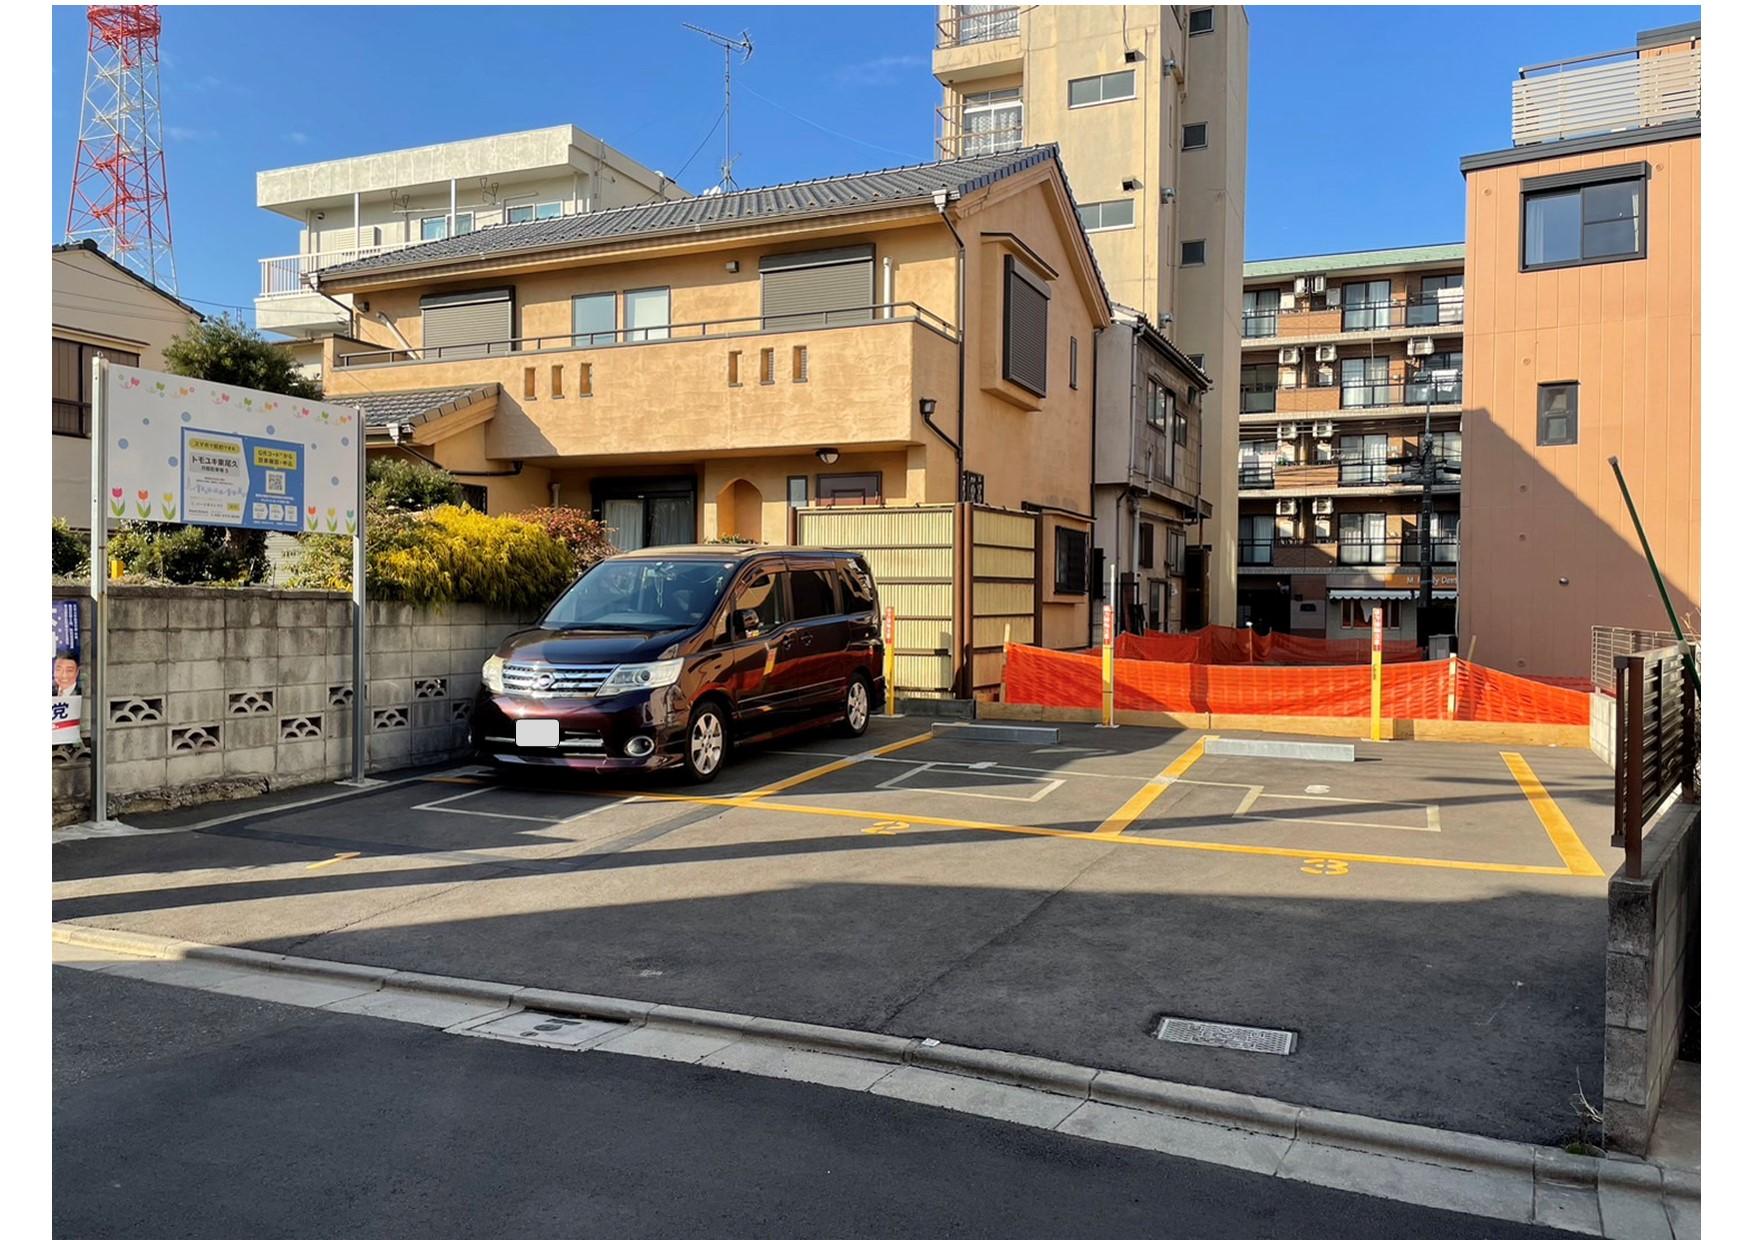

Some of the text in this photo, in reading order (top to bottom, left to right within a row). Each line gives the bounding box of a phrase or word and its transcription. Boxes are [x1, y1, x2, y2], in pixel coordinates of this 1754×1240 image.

[192, 455, 239, 468] トモユキ東尾久
[52, 701, 69, 720] 党
[861, 821, 910, 836] 2
[1300, 859, 1349, 875] 3
